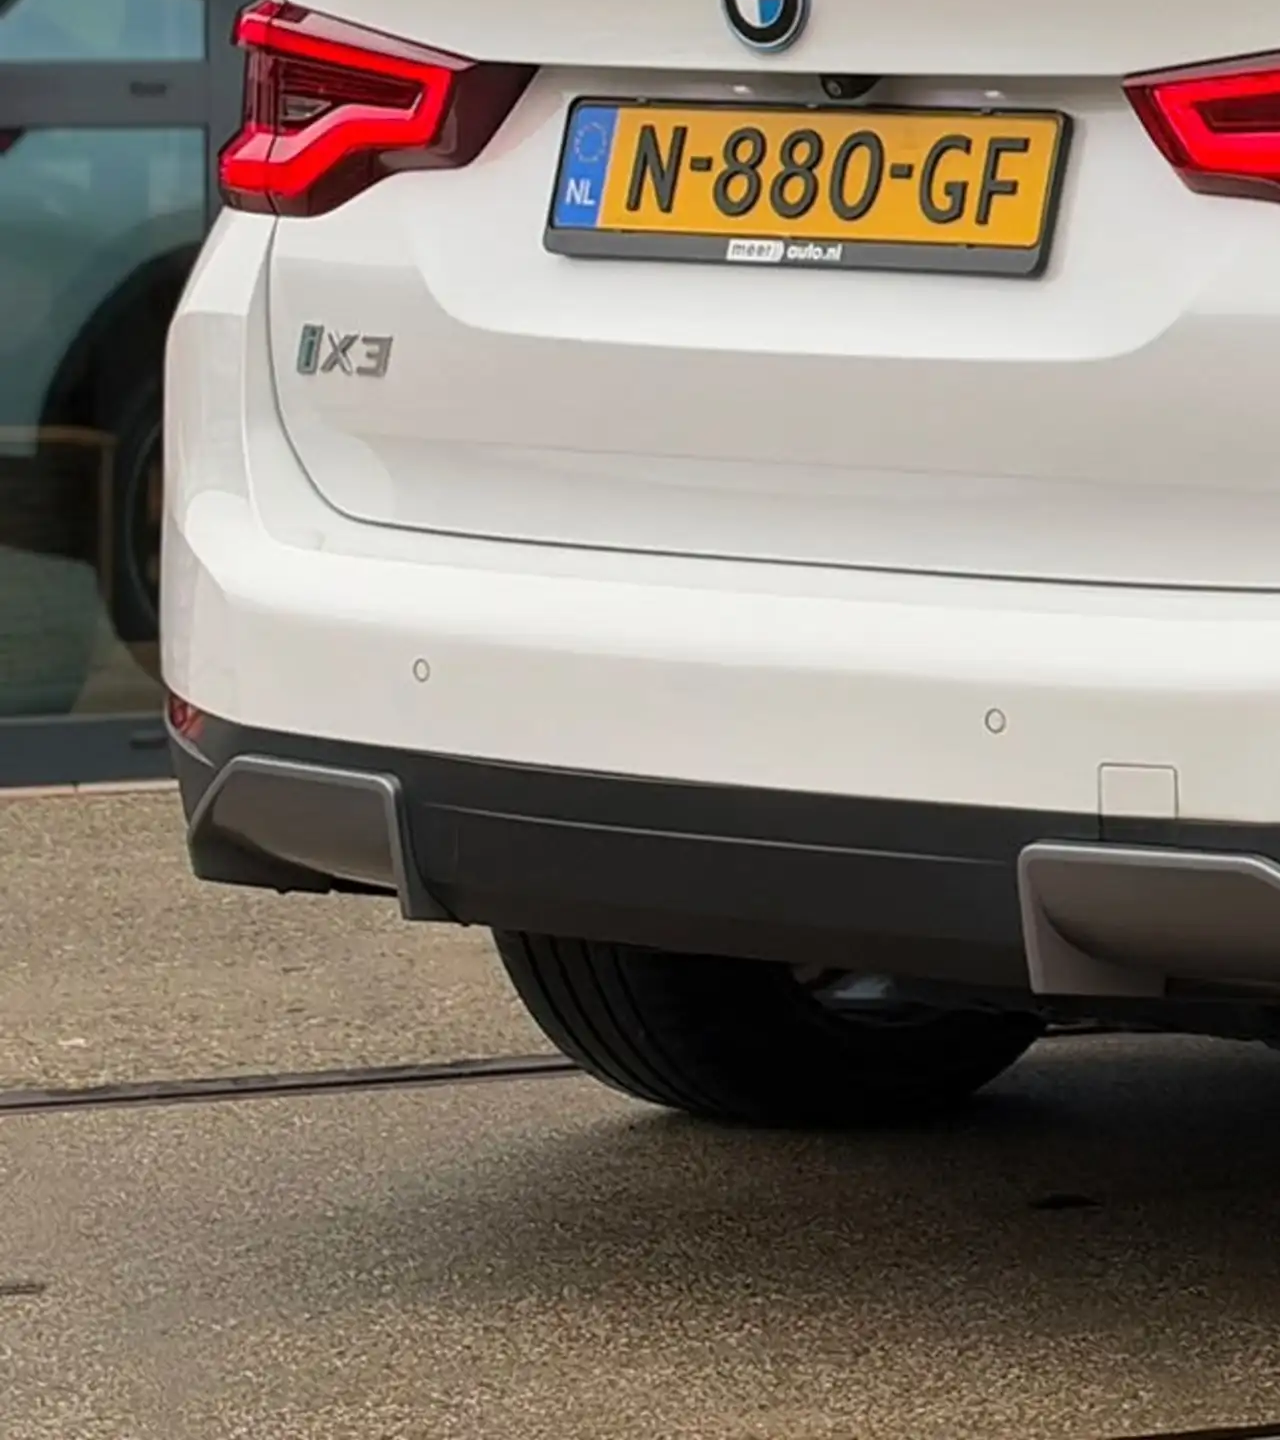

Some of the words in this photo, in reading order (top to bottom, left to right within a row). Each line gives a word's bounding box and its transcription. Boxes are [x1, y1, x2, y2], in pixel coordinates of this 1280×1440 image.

[565, 178, 595, 205] NL
[626, 124, 1031, 225] N-880-GF
[786, 243, 843, 261] auto.nl
[297, 323, 393, 377] iX3
